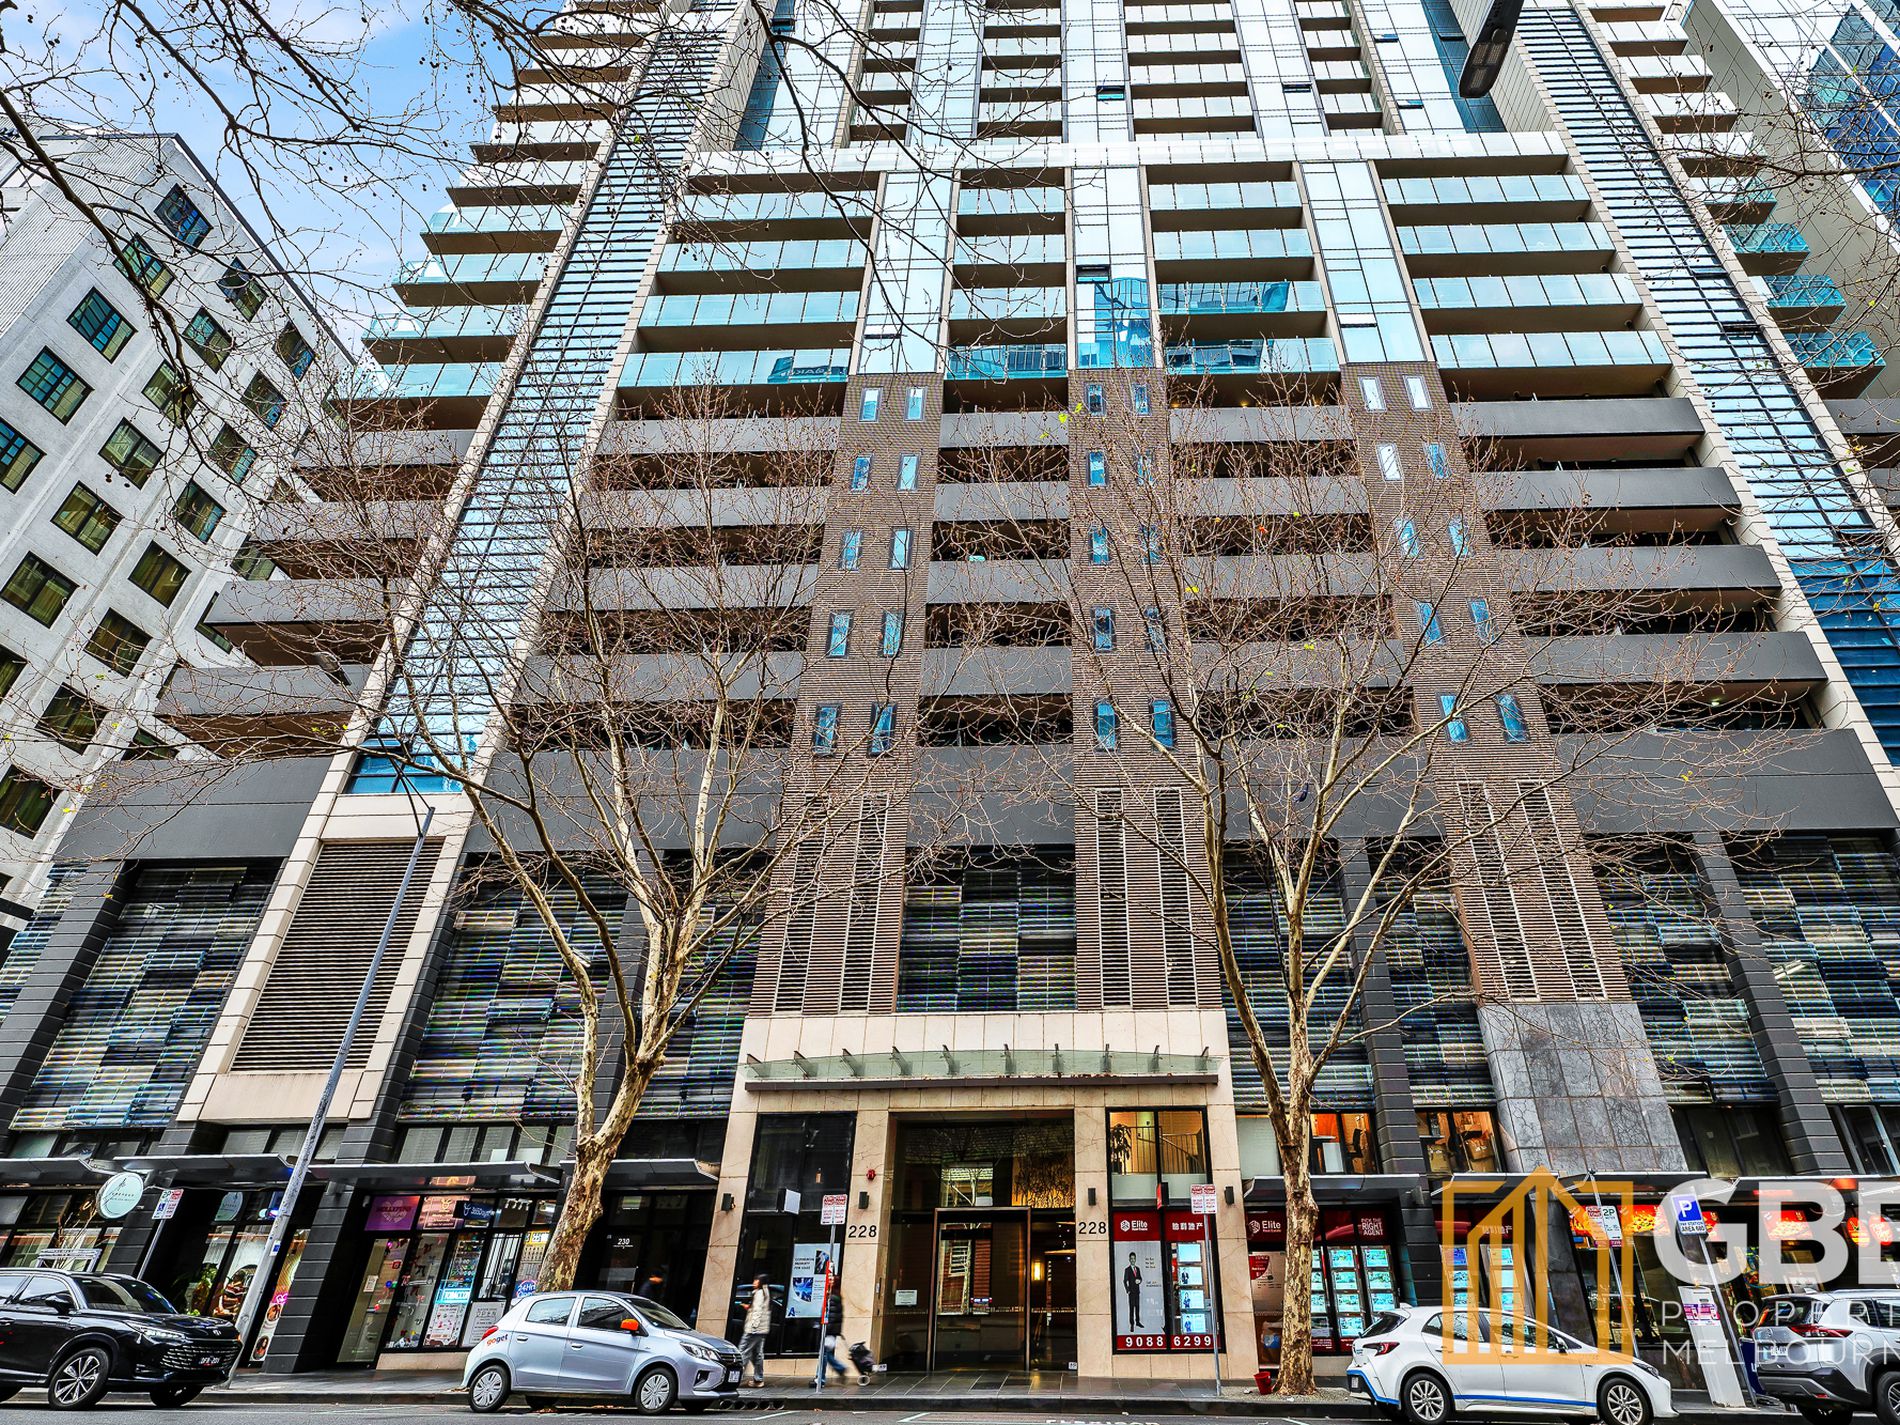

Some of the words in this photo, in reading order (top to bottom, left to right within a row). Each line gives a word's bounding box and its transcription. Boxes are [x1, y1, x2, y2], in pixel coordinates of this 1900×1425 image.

[1602, 1208, 1616, 1217] 2P
[1678, 1200, 1693, 1218] P
[1078, 1221, 1107, 1235] 228
[1131, 1220, 1148, 1228] Elite
[1262, 1220, 1282, 1229] Elite
[848, 1224, 877, 1238] 228
[486, 1334, 509, 1346] goget
[1125, 1336, 1164, 1347] 9088
[1173, 1335, 1212, 1346] 6299
